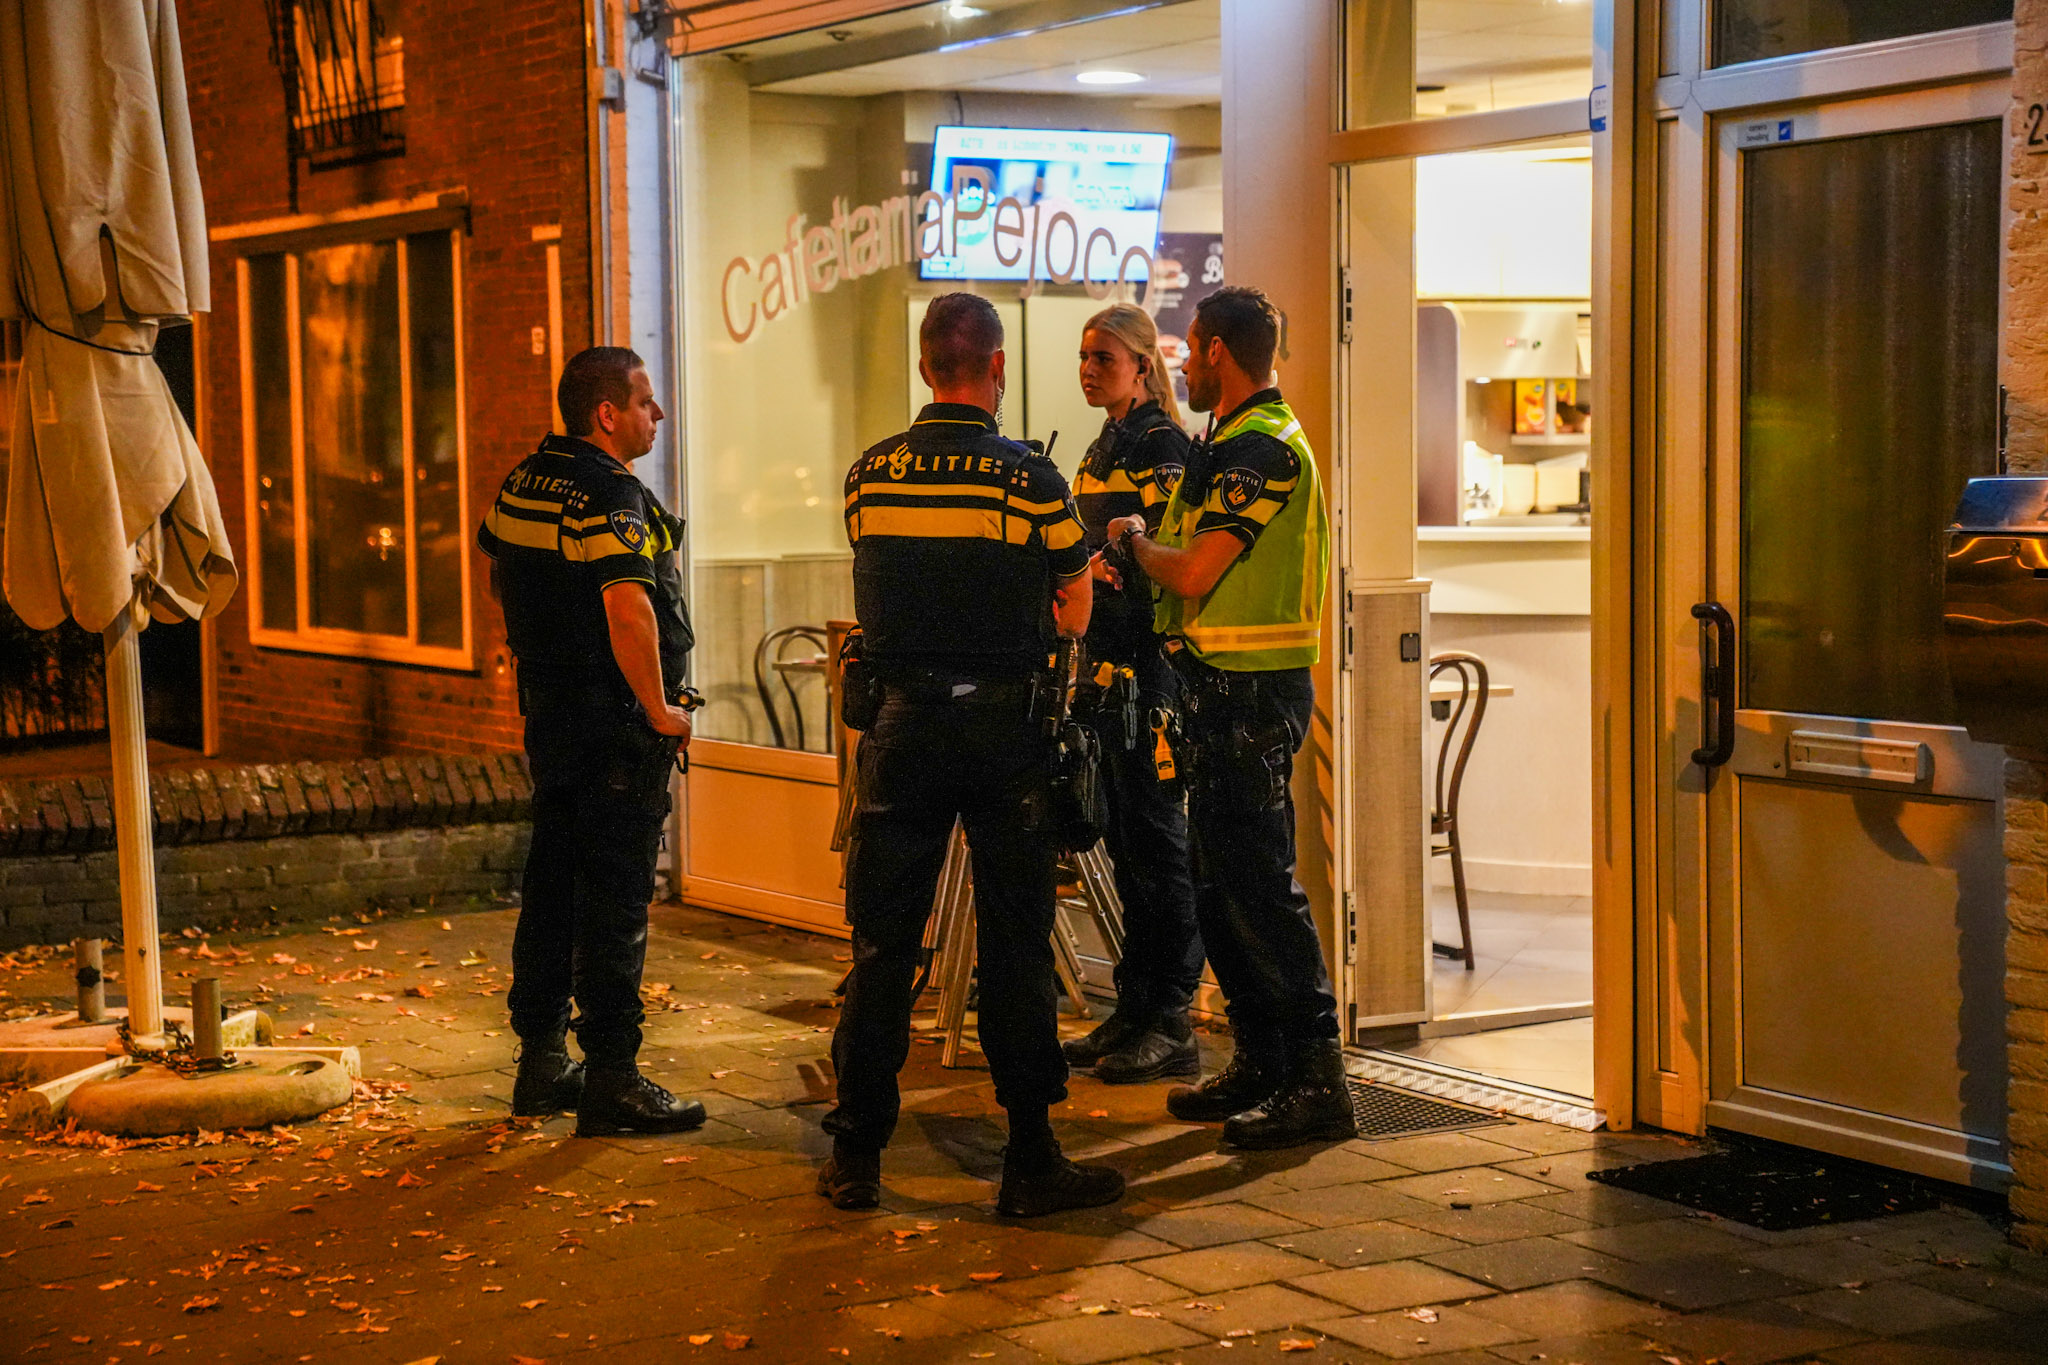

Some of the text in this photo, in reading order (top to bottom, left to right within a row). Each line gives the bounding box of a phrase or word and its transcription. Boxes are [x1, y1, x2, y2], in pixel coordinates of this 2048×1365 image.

[2028, 103, 2048, 146] 2
[951, 165, 1155, 316] Pejoco
[874, 446, 993, 480] POLITIE
[1227, 471, 1259, 486] POLITIE
